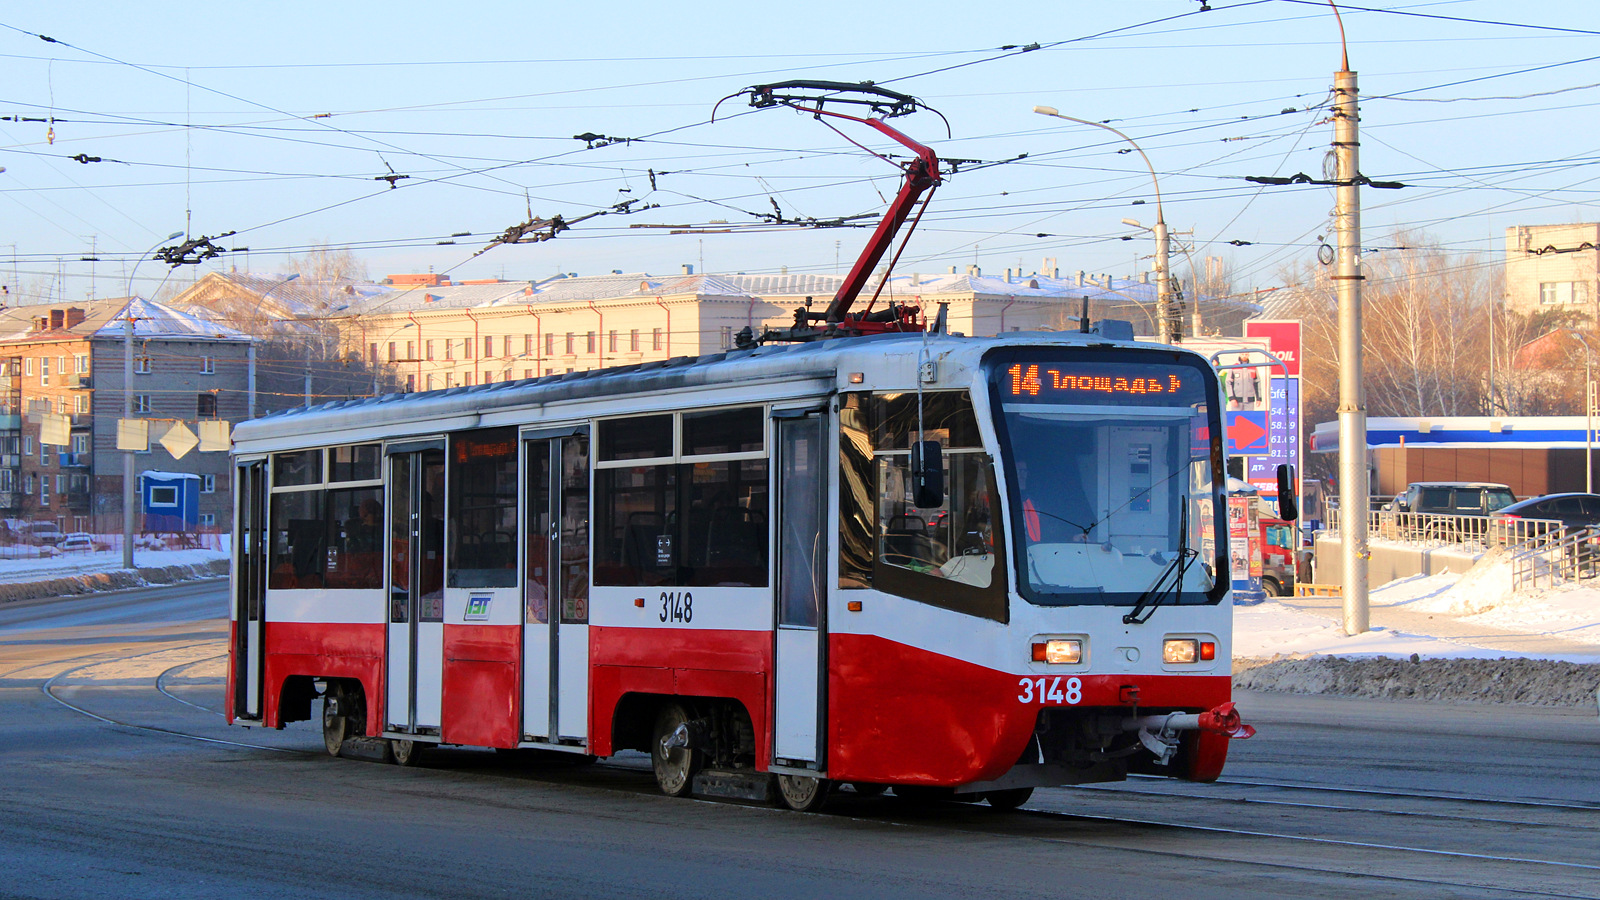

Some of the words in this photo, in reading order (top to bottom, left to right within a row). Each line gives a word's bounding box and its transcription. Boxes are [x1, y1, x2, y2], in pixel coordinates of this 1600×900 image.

[1008, 364, 1041, 395] 14
[659, 591, 693, 623] 3148
[1017, 676, 1082, 704] 3148
